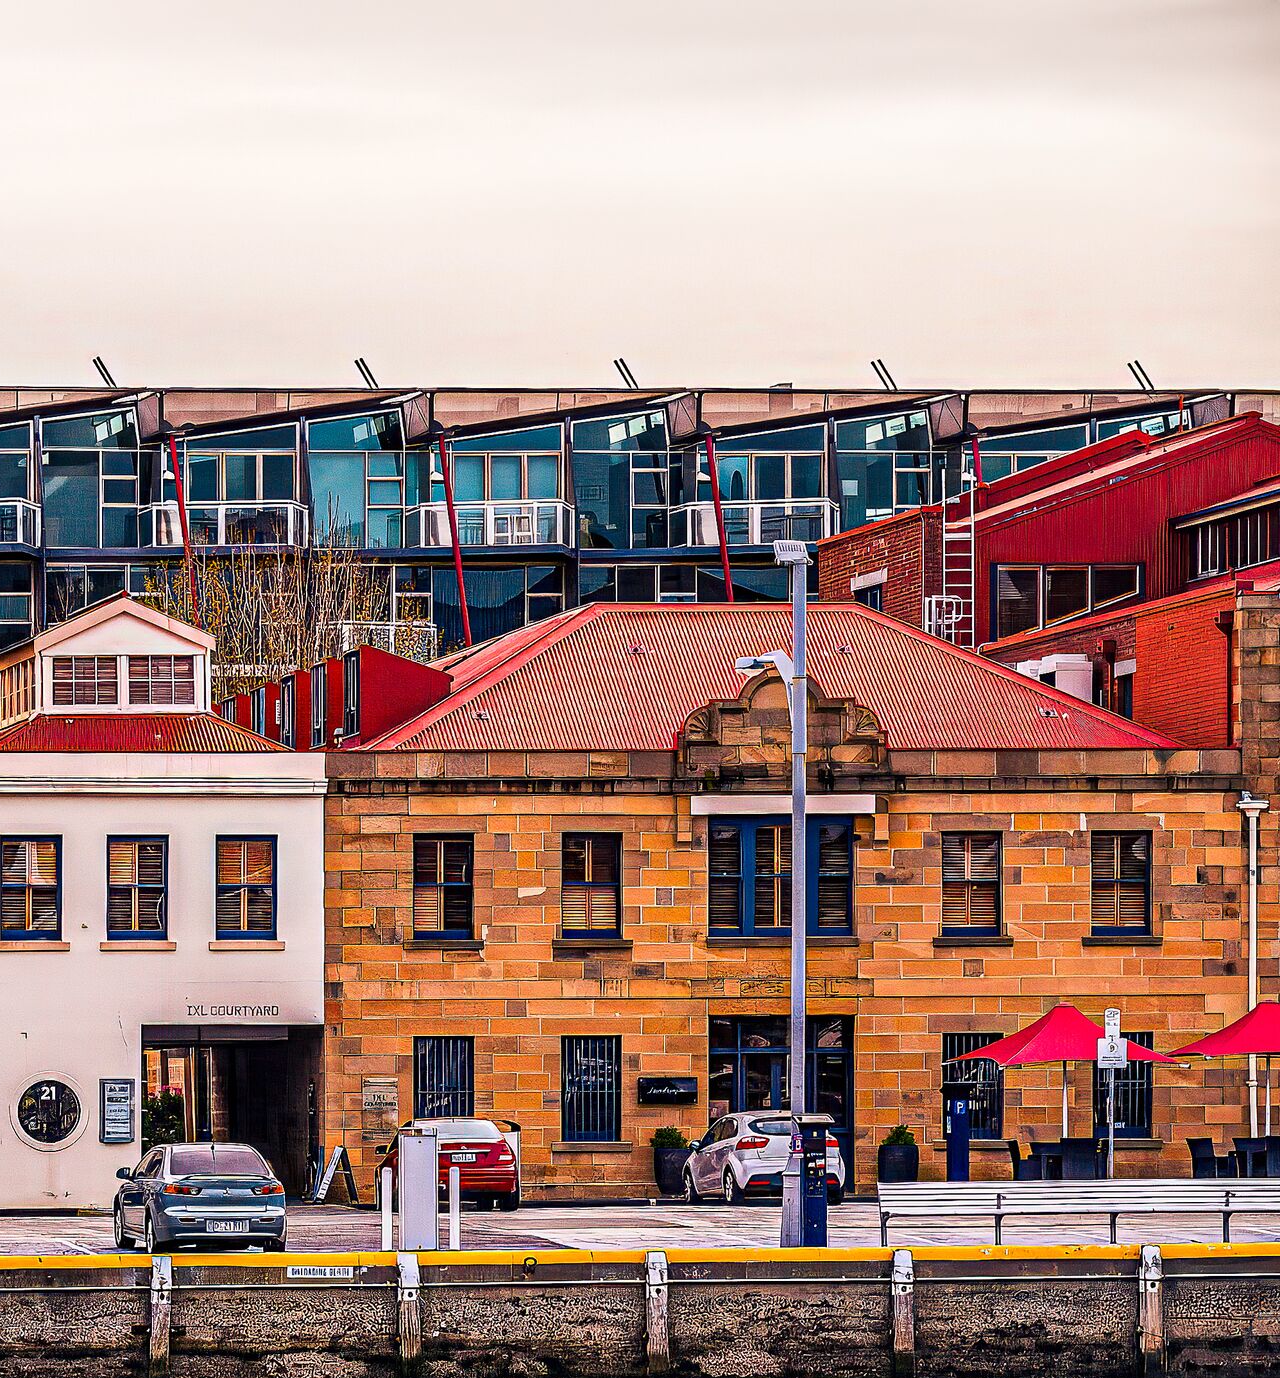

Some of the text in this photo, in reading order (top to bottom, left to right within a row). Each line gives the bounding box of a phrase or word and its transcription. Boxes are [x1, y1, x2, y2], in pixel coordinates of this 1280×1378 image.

[186, 1005, 279, 1016] IXL COURTYARD
[41, 1087, 56, 1100] 21
